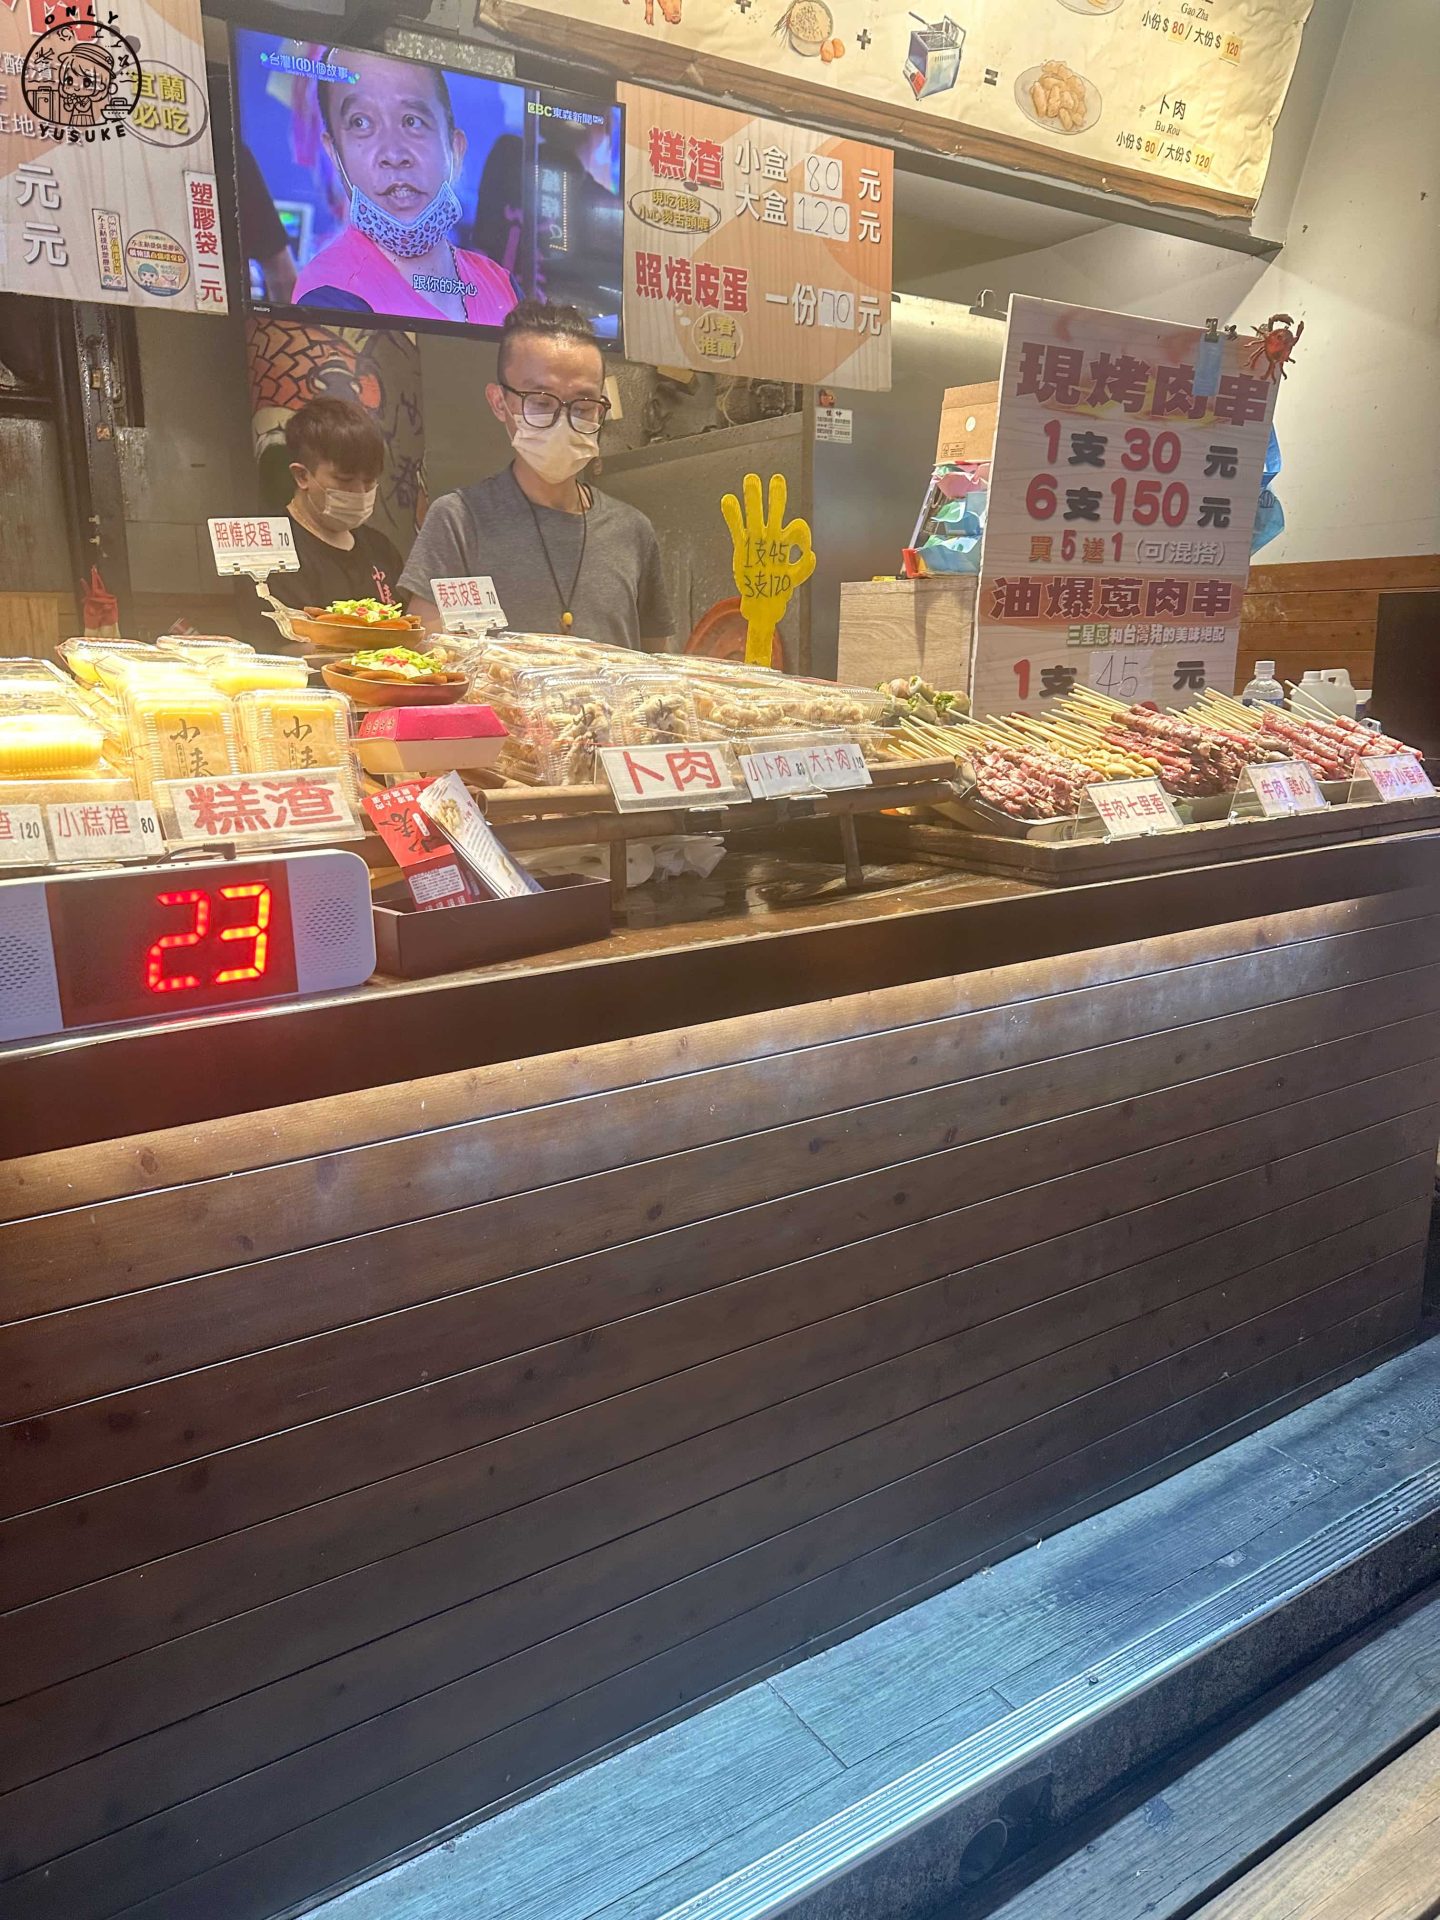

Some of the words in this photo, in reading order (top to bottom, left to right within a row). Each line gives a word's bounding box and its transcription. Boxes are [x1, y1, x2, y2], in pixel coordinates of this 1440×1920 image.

[1181, 2, 1196, 17] Gao
[1196, 8, 1210, 22] Zha
[131, 71, 187, 104] 宜蘭
[132, 102, 191, 135] 必吃
[1159, 94, 1187, 120] 卜肉
[1154, 120, 1166, 132] Bu
[1167, 124, 1181, 136] Rou
[648, 127, 724, 189] 糕渣
[735, 139, 788, 183] 小盒
[806, 155, 841, 193] 80
[858, 167, 882, 203] 元
[15, 163, 61, 210] 元
[735, 183, 788, 226] 大盒
[798, 196, 849, 235] 120
[858, 210, 882, 244] 元
[23, 222, 69, 268] 元
[190, 181, 224, 303] 塑膠袋一元
[413, 274, 478, 296] 跟你的決心
[635, 251, 748, 313] 照燒皮蛋
[858, 296, 883, 337] 元
[699, 313, 736, 338] 小春
[699, 337, 737, 359] 推薦
[1016, 342, 1270, 427] 現烤肉串
[1121, 427, 1182, 473] 30
[1203, 445, 1239, 480] 元
[1111, 477, 1190, 527] 150
[1197, 496, 1233, 529] 元
[214, 521, 273, 548] 照燒皮蛋
[278, 532, 290, 547] 70
[437, 580, 483, 608] 泰式皮蛋
[486, 591, 496, 605] 70
[990, 576, 1234, 620] 油爆蔥肉串
[1096, 655, 1139, 699] 45
[1173, 660, 1206, 691] 元
[623, 748, 722, 795] 卜肉
[747, 756, 792, 782] 小卜肉
[809, 748, 851, 773] 大卜肉
[184, 776, 343, 837] 糕渣
[1261, 779, 1287, 800] 牛肉
[57, 804, 132, 839] 小糕渣
[140, 817, 156, 835] 80
[1098, 793, 1168, 822] 羊肉七里香
[20, 821, 40, 840] 120
[146, 883, 272, 994] 23
